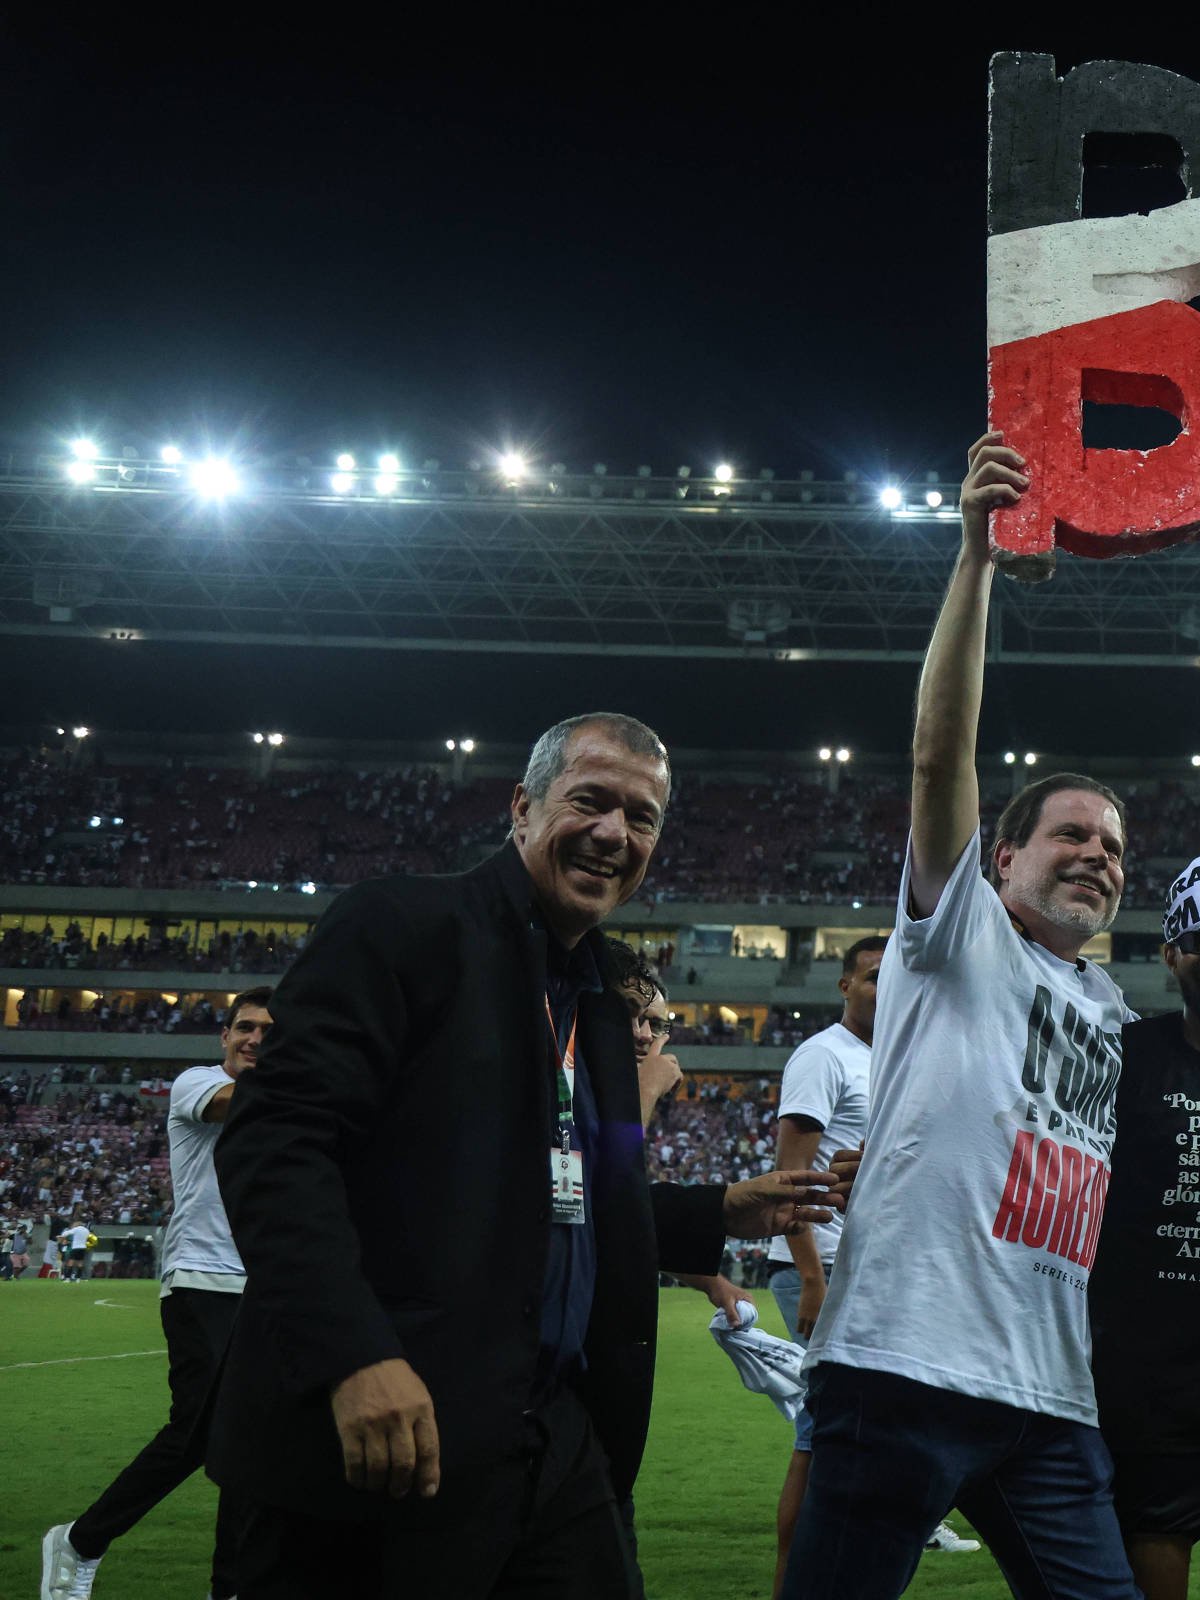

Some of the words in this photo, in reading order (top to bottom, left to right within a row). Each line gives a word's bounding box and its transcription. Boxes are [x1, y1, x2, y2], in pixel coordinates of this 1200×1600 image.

[1021, 984, 1055, 1093] O
[1175, 1132, 1188, 1145] e
[1178, 1171, 1199, 1184] as
[1074, 1279, 1087, 1292] 20
